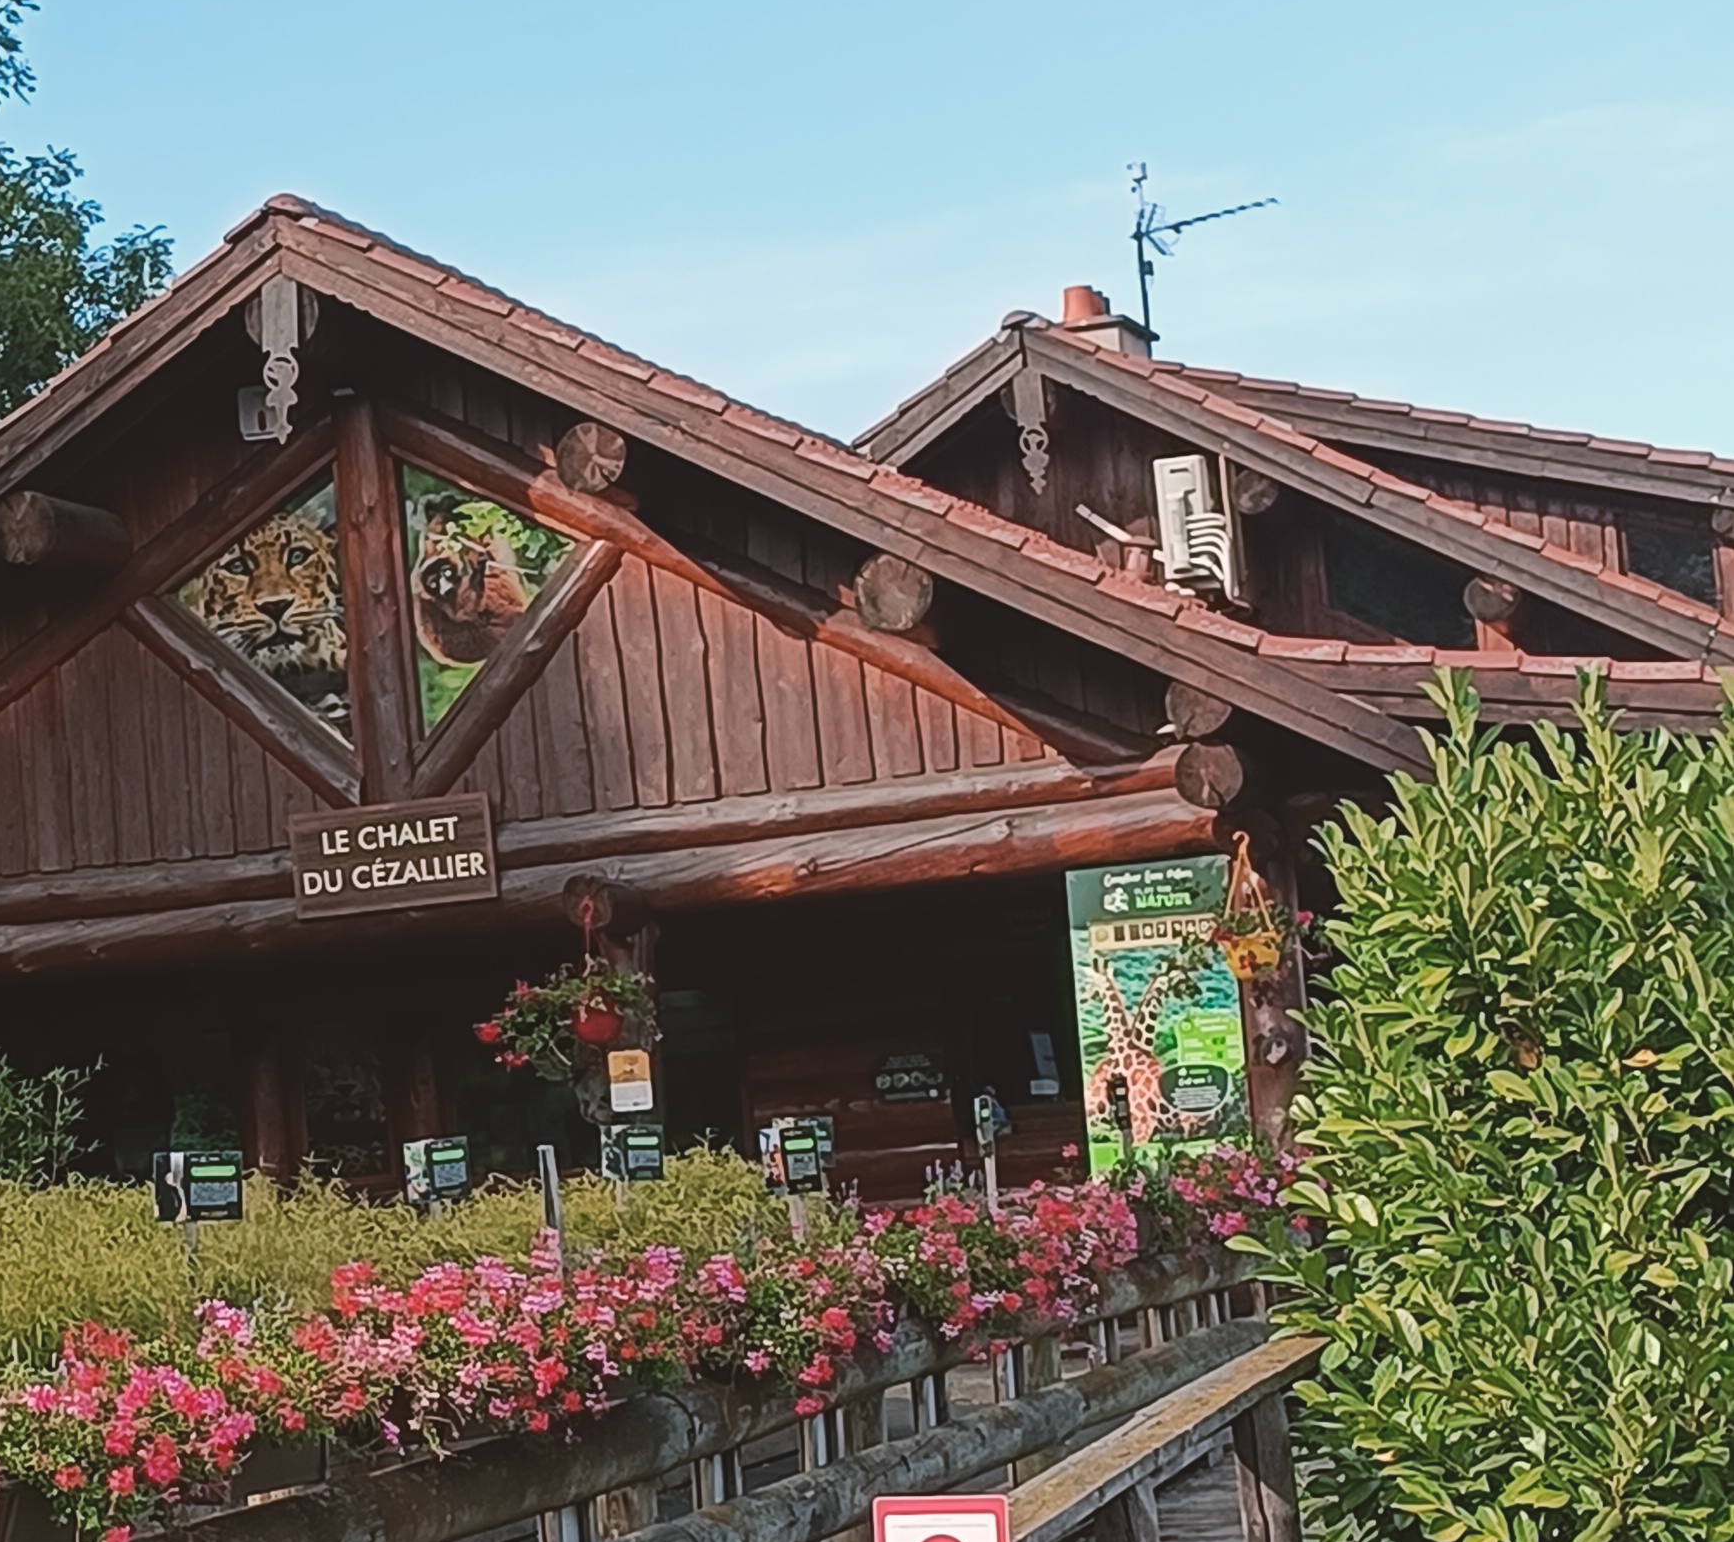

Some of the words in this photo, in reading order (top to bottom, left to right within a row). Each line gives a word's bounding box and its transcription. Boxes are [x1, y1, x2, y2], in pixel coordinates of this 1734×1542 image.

[321, 829, 350, 855] LE
[357, 815, 459, 851] CHALET
[302, 868, 344, 896] DU
[350, 852, 488, 890] CÉZALLIER
